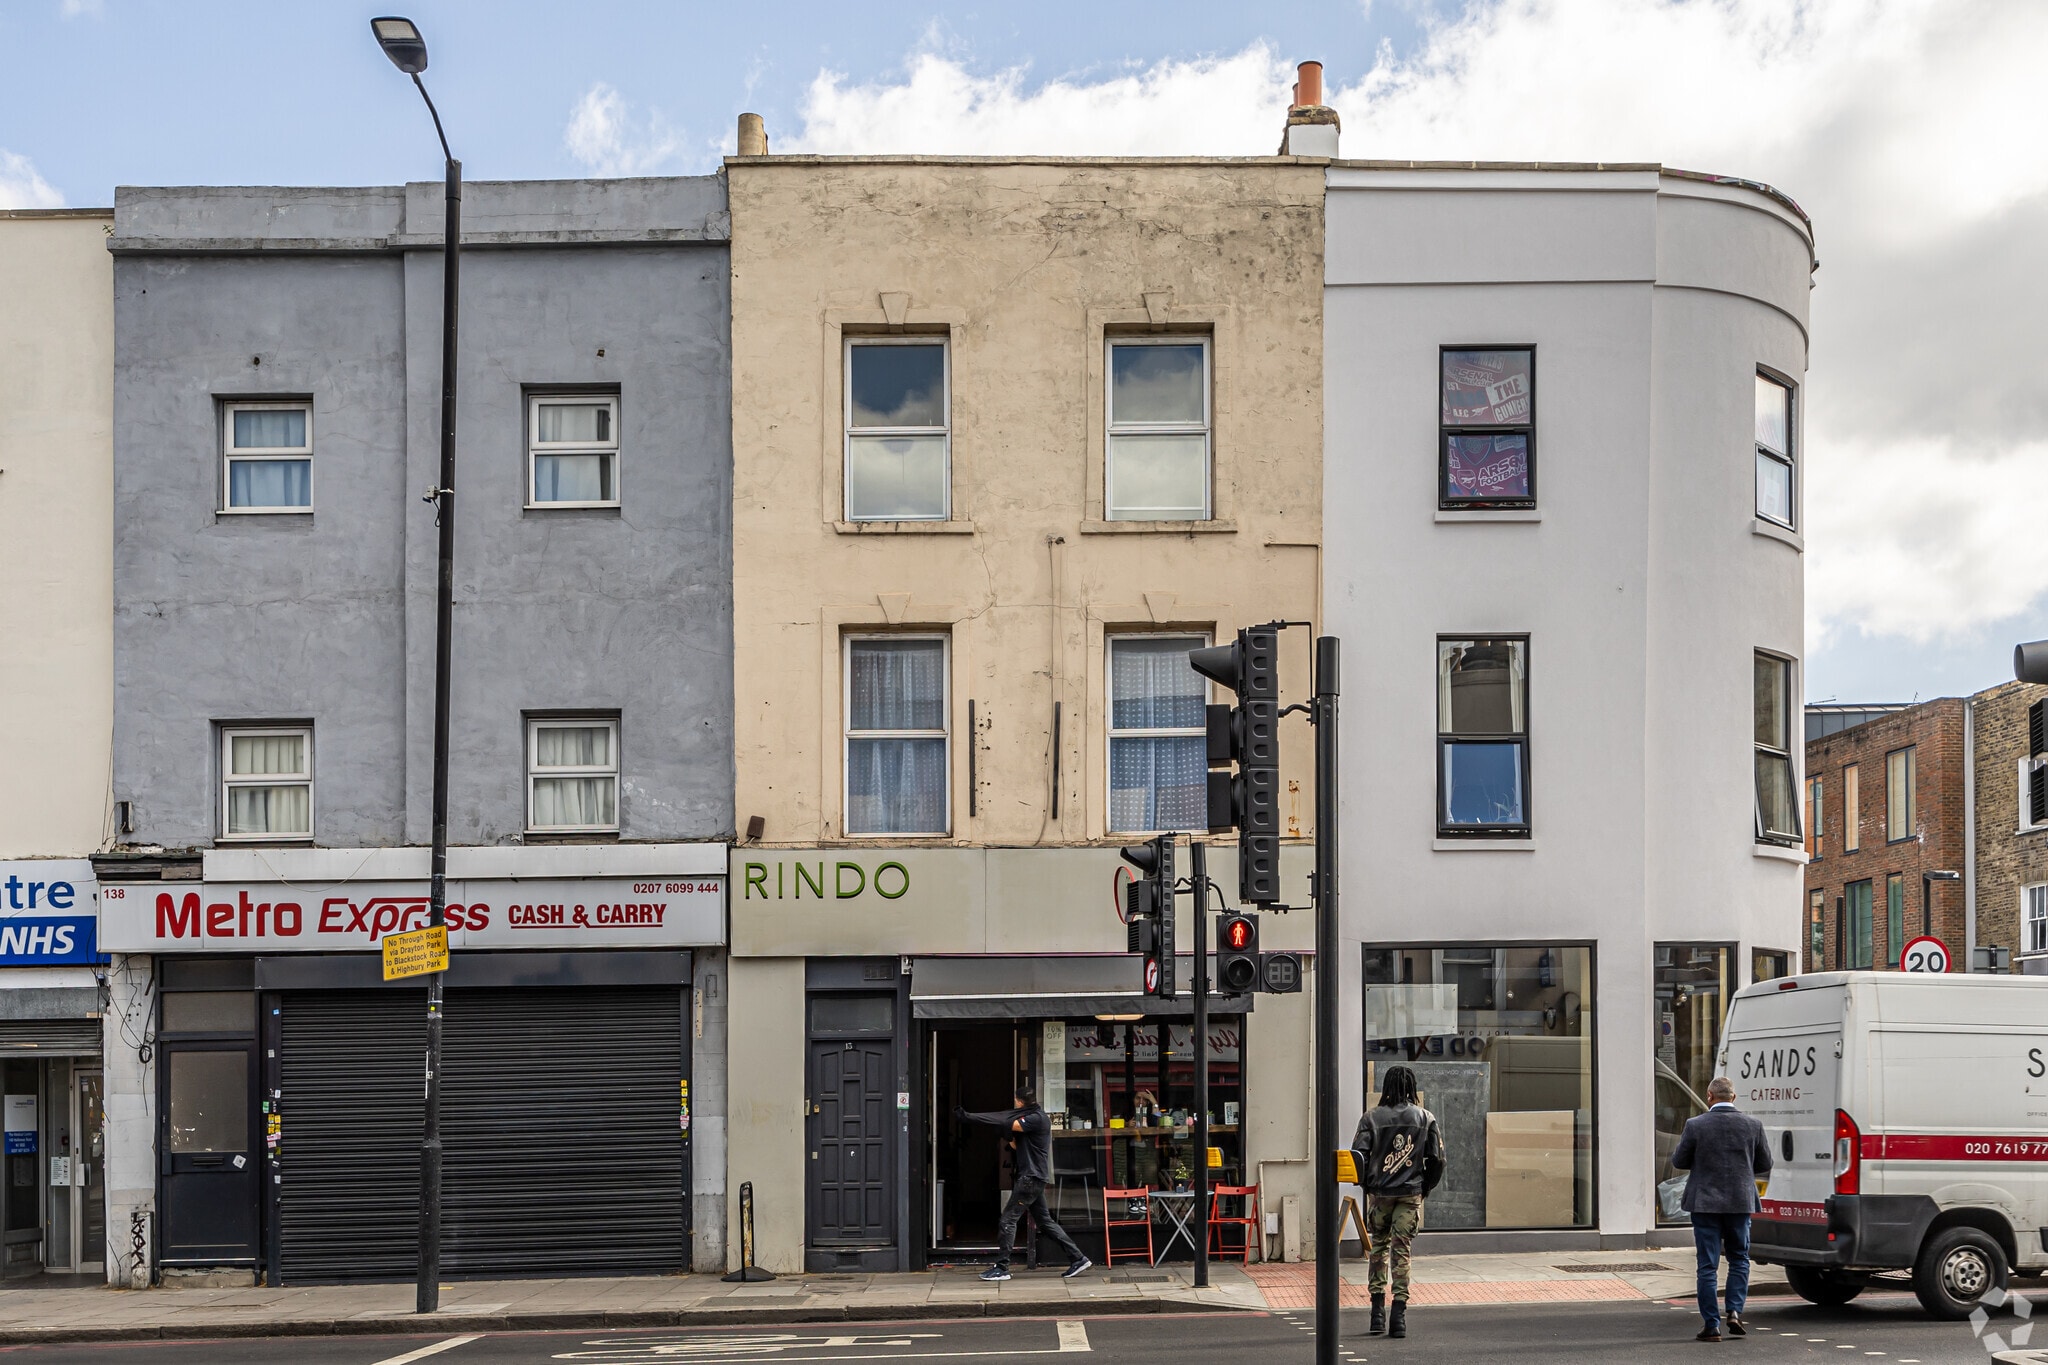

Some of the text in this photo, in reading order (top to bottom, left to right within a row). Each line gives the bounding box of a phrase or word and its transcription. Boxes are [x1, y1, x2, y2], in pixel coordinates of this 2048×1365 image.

[1493, 378, 1522, 401] THE
[1494, 396, 1528, 423] GUNNER
[633, 882, 719, 894] 0207 6099 444
[745, 861, 910, 900] RINDO
[0, 874, 75, 910] tre
[103, 888, 125, 899] 138
[155, 890, 667, 941] Metro Exprss CASH & CARRY
[0, 924, 76, 955] NHS
[388, 930, 442, 948] No Through Road
[400, 944, 424, 954] Drayton
[426, 940, 441, 949] Park
[394, 952, 428, 965] Blackstock
[429, 949, 446, 958] Road
[396, 963, 424, 975] Highbury
[426, 959, 441, 969] Park
[1908, 951, 1944, 973] 20
[1741, 1046, 1816, 1079] SANDS
[2027, 1048, 2046, 1078] S
[1750, 1087, 1801, 1101] CATERING
[1965, 1142, 2048, 1154] 020 7619 77
[1779, 1206, 1793, 1216] 020
[1793, 1207, 1811, 1217] 7619
